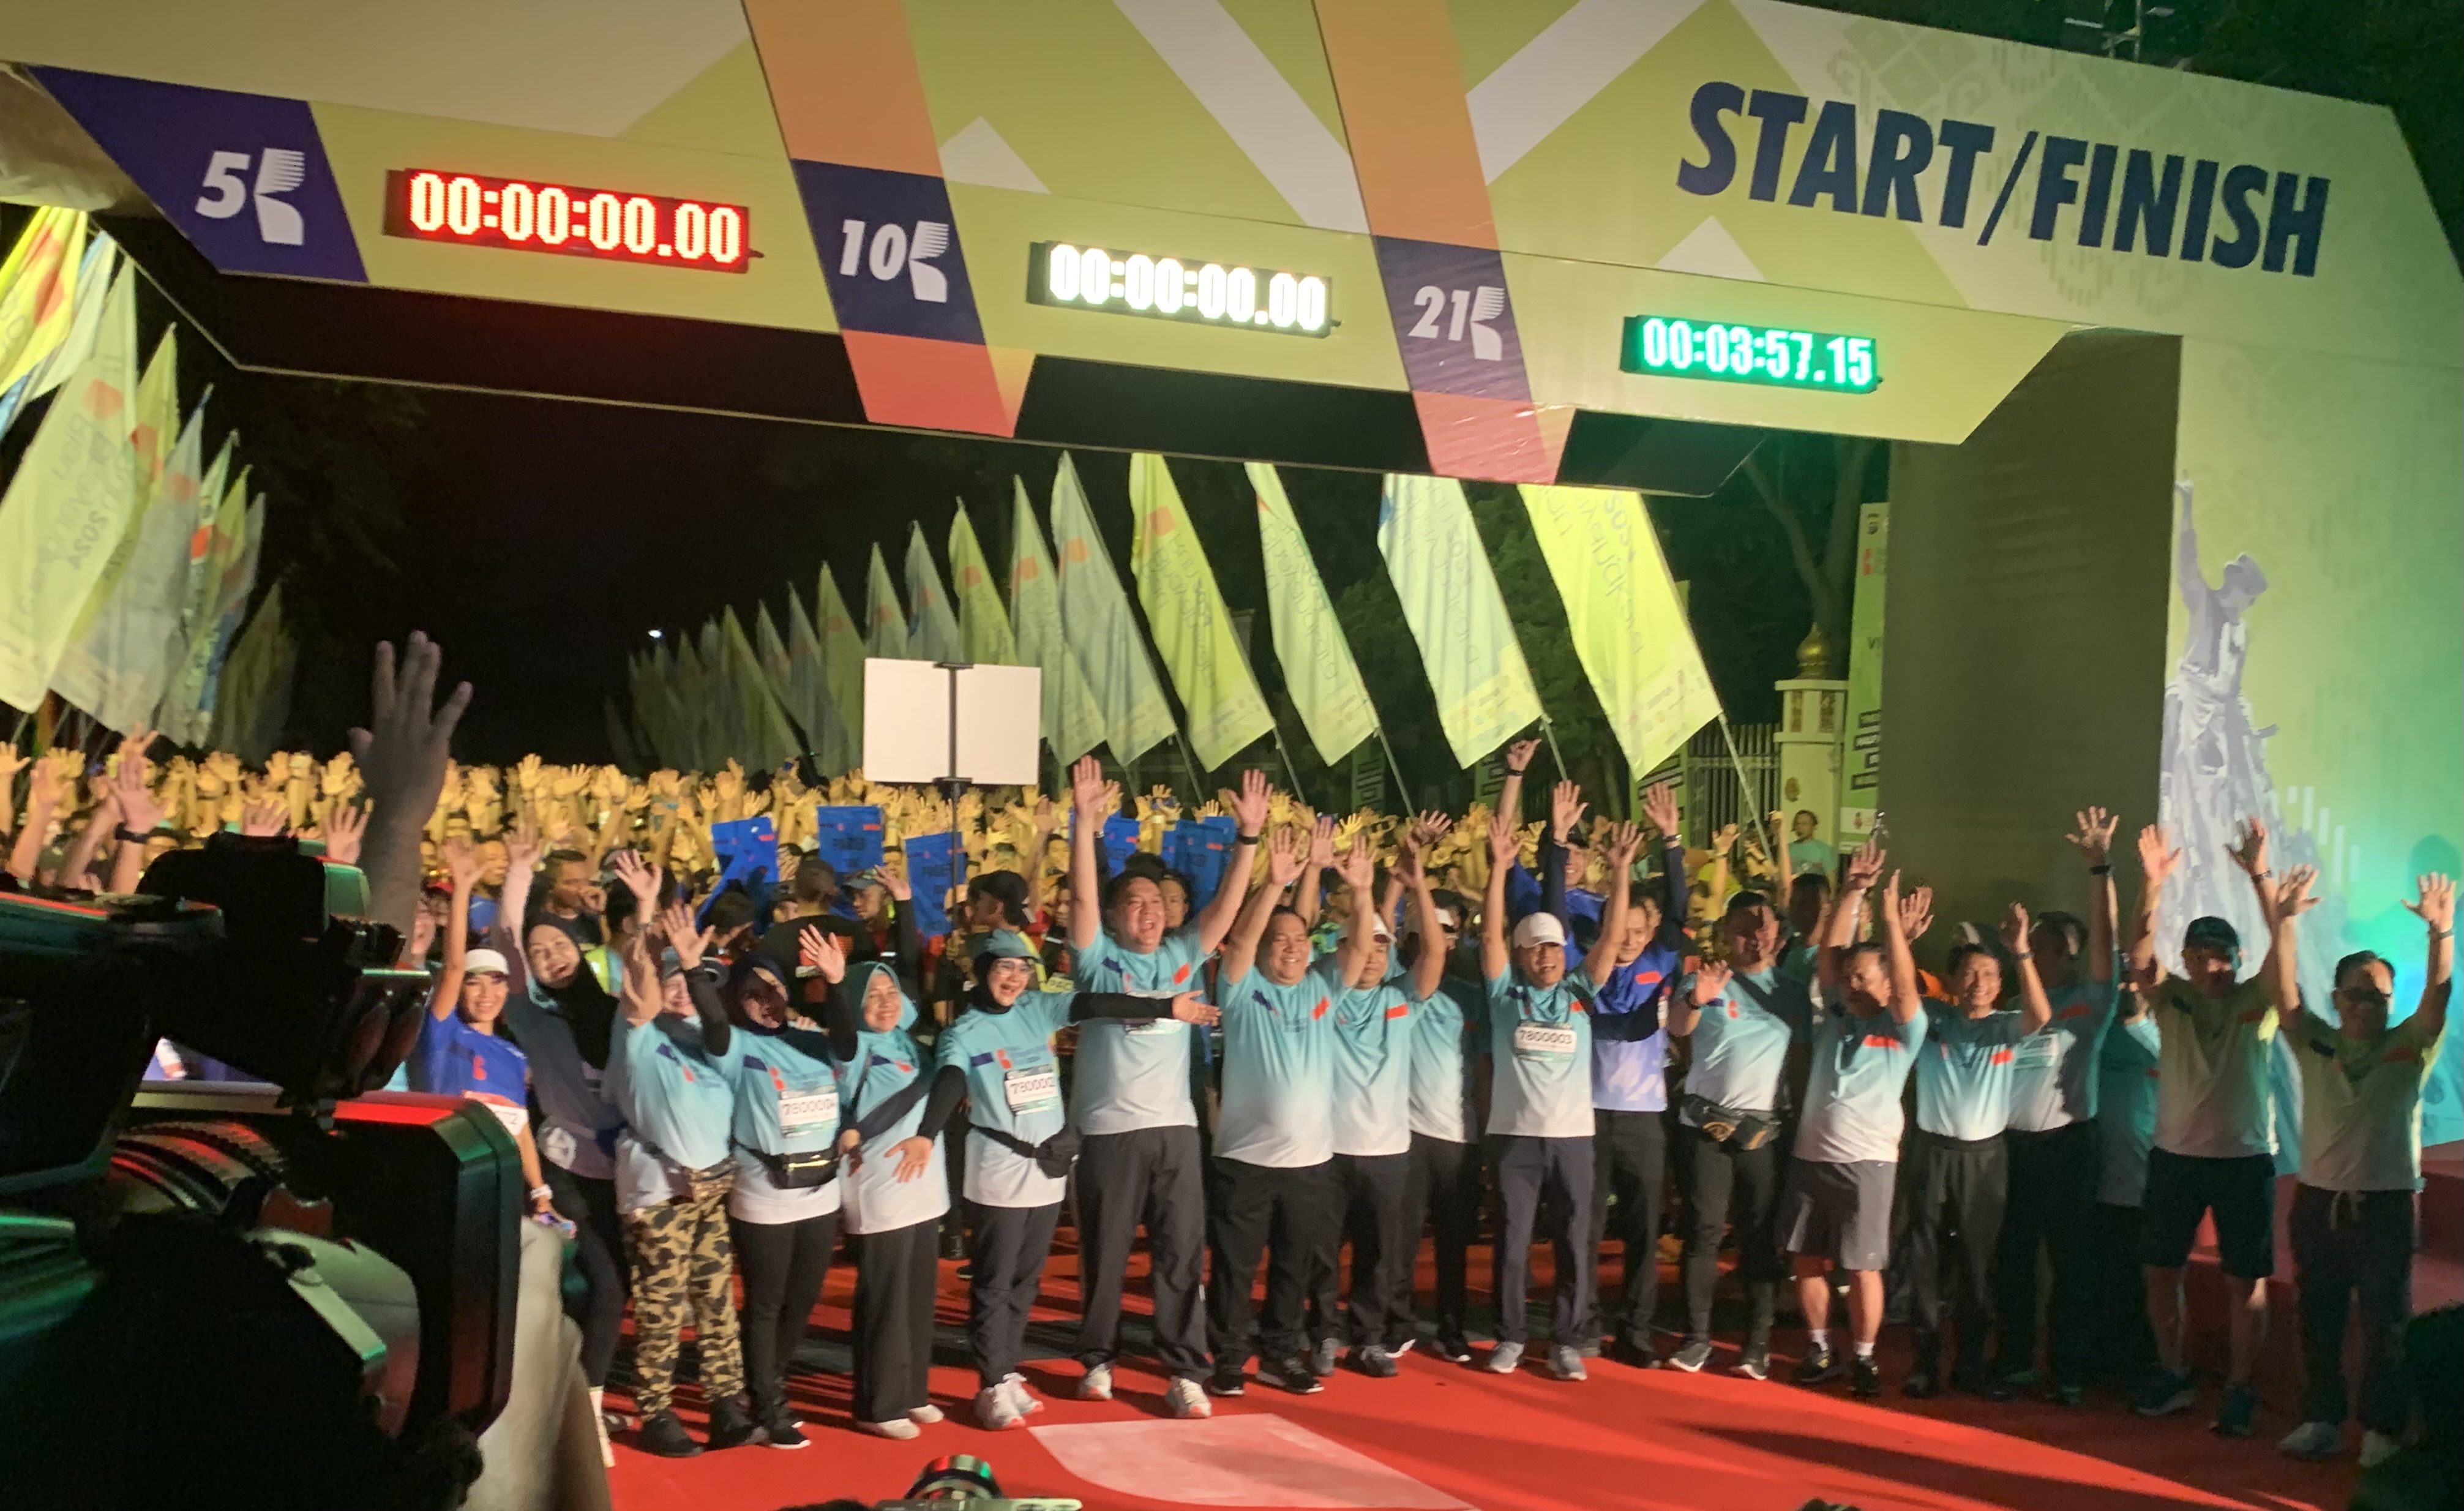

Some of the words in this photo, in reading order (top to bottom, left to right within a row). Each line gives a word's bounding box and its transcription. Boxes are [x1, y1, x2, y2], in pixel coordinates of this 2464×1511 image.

[408, 172, 741, 264] 00:00:00.00
[1676, 81, 2331, 277] START/FINISH
[1049, 243, 1325, 331] 00:00:00.00
[1642, 317, 1873, 387] 00:03:57.15
